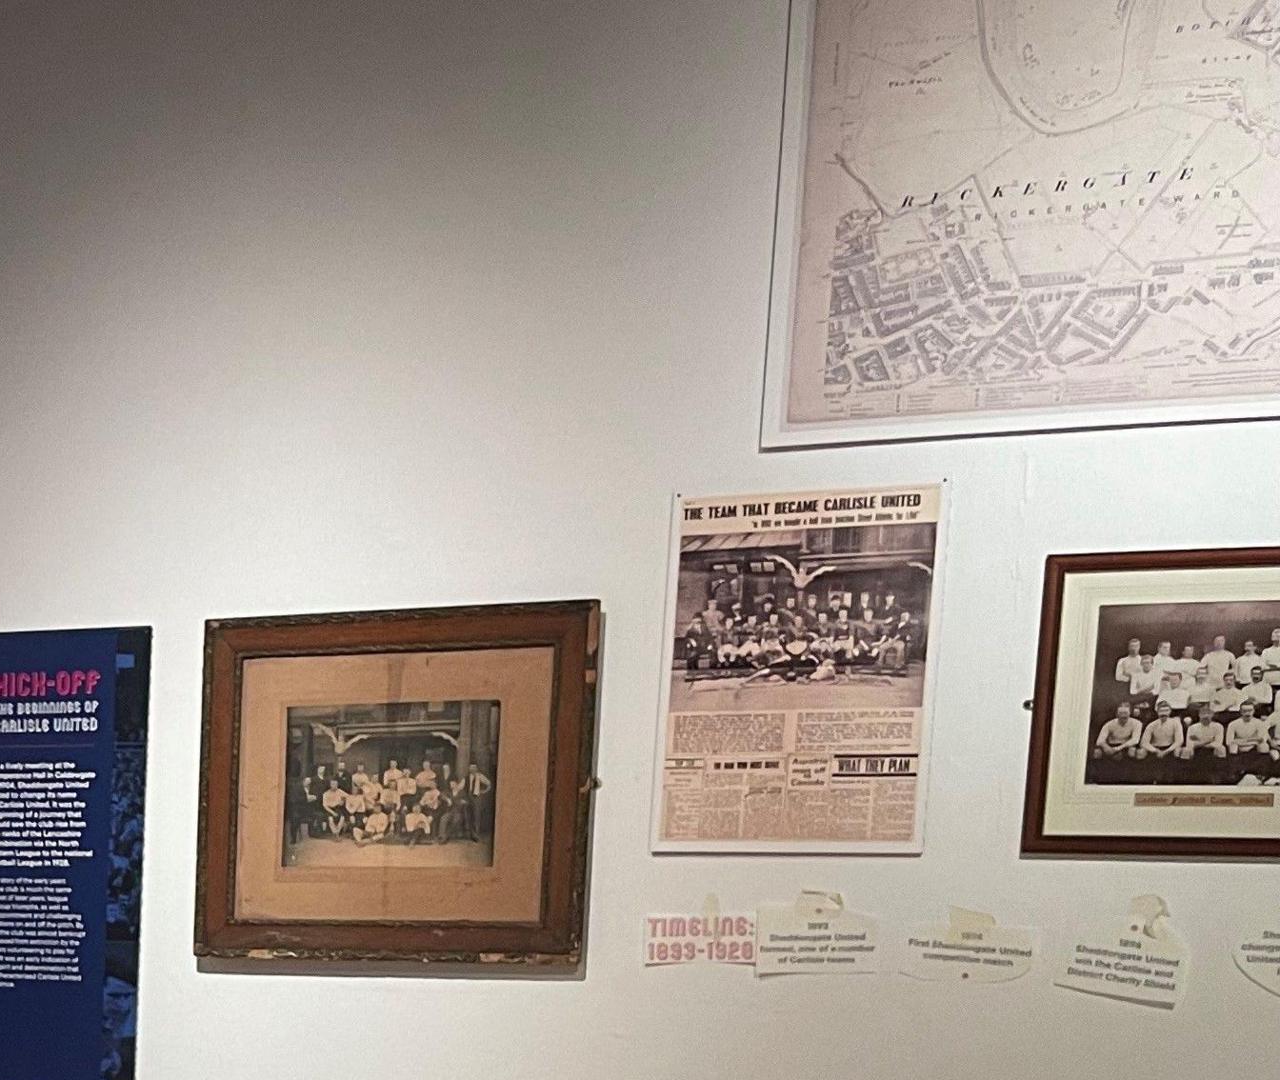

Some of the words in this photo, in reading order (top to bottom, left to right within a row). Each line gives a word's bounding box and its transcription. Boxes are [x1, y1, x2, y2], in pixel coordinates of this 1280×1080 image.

[901, 167, 1193, 208] RICKERGATE
[684, 507, 703, 520] THE
[708, 505, 737, 519] TEAM
[742, 502, 769, 516] THAT
[774, 500, 818, 514] BECAME
[823, 496, 875, 511] CARLISLE
[881, 494, 921, 507] UNITED
[17, 701, 81, 714] BEGINNINGS
[84, 700, 99, 713] OF
[53, 717, 98, 732] UNITED
[838, 759, 860, 771] WHAT
[865, 759, 884, 772] THEY
[888, 759, 910, 772] PLAN
